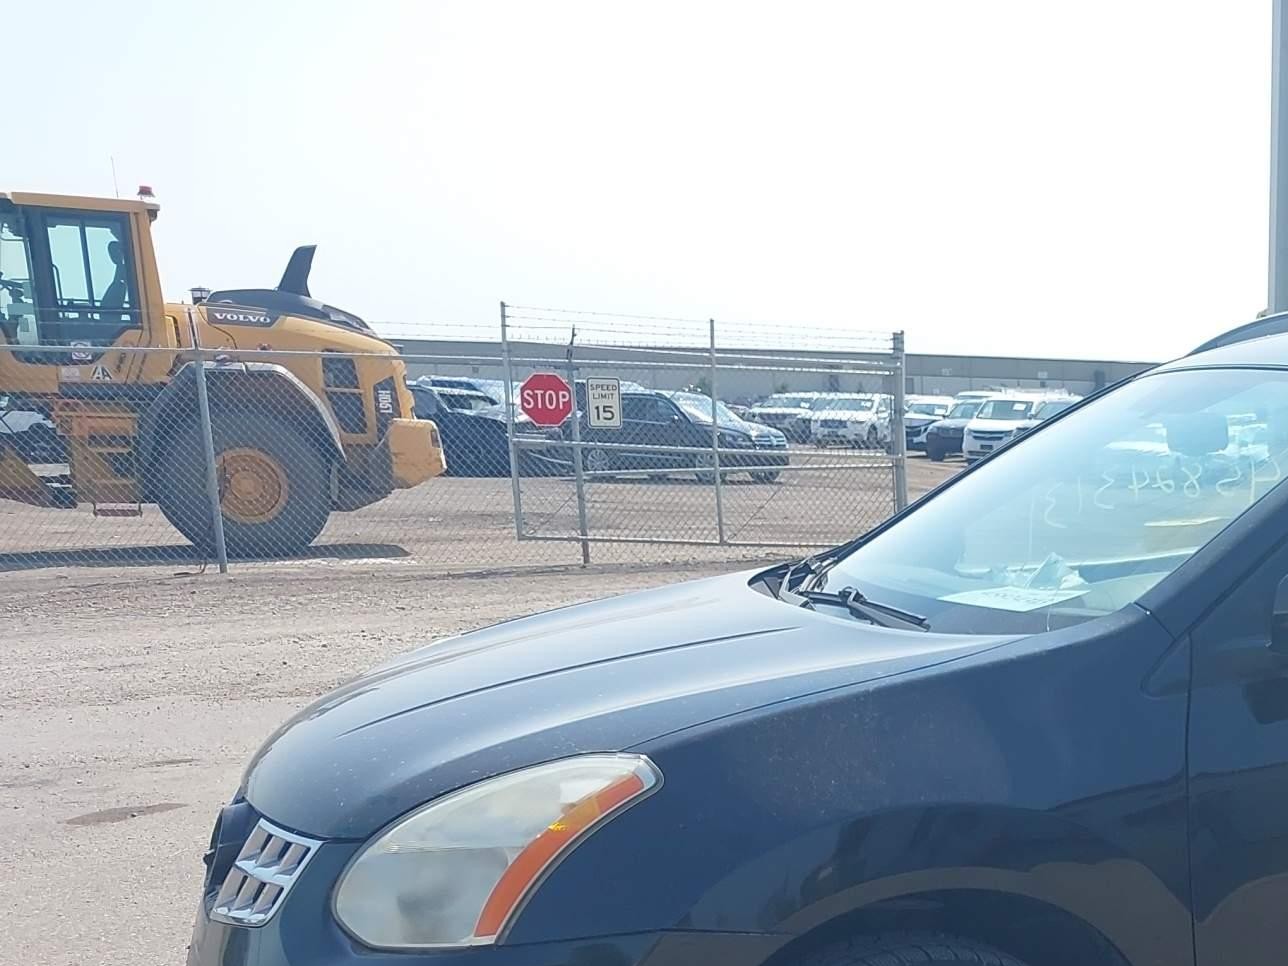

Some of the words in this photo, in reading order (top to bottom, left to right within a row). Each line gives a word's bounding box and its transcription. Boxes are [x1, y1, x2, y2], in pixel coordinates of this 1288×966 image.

[213, 312, 272, 324] VOLVO
[377, 389, 394, 414] L90H
[523, 390, 570, 410] STOP
[592, 392, 615, 401] LIMIT
[594, 405, 615, 421] 15
